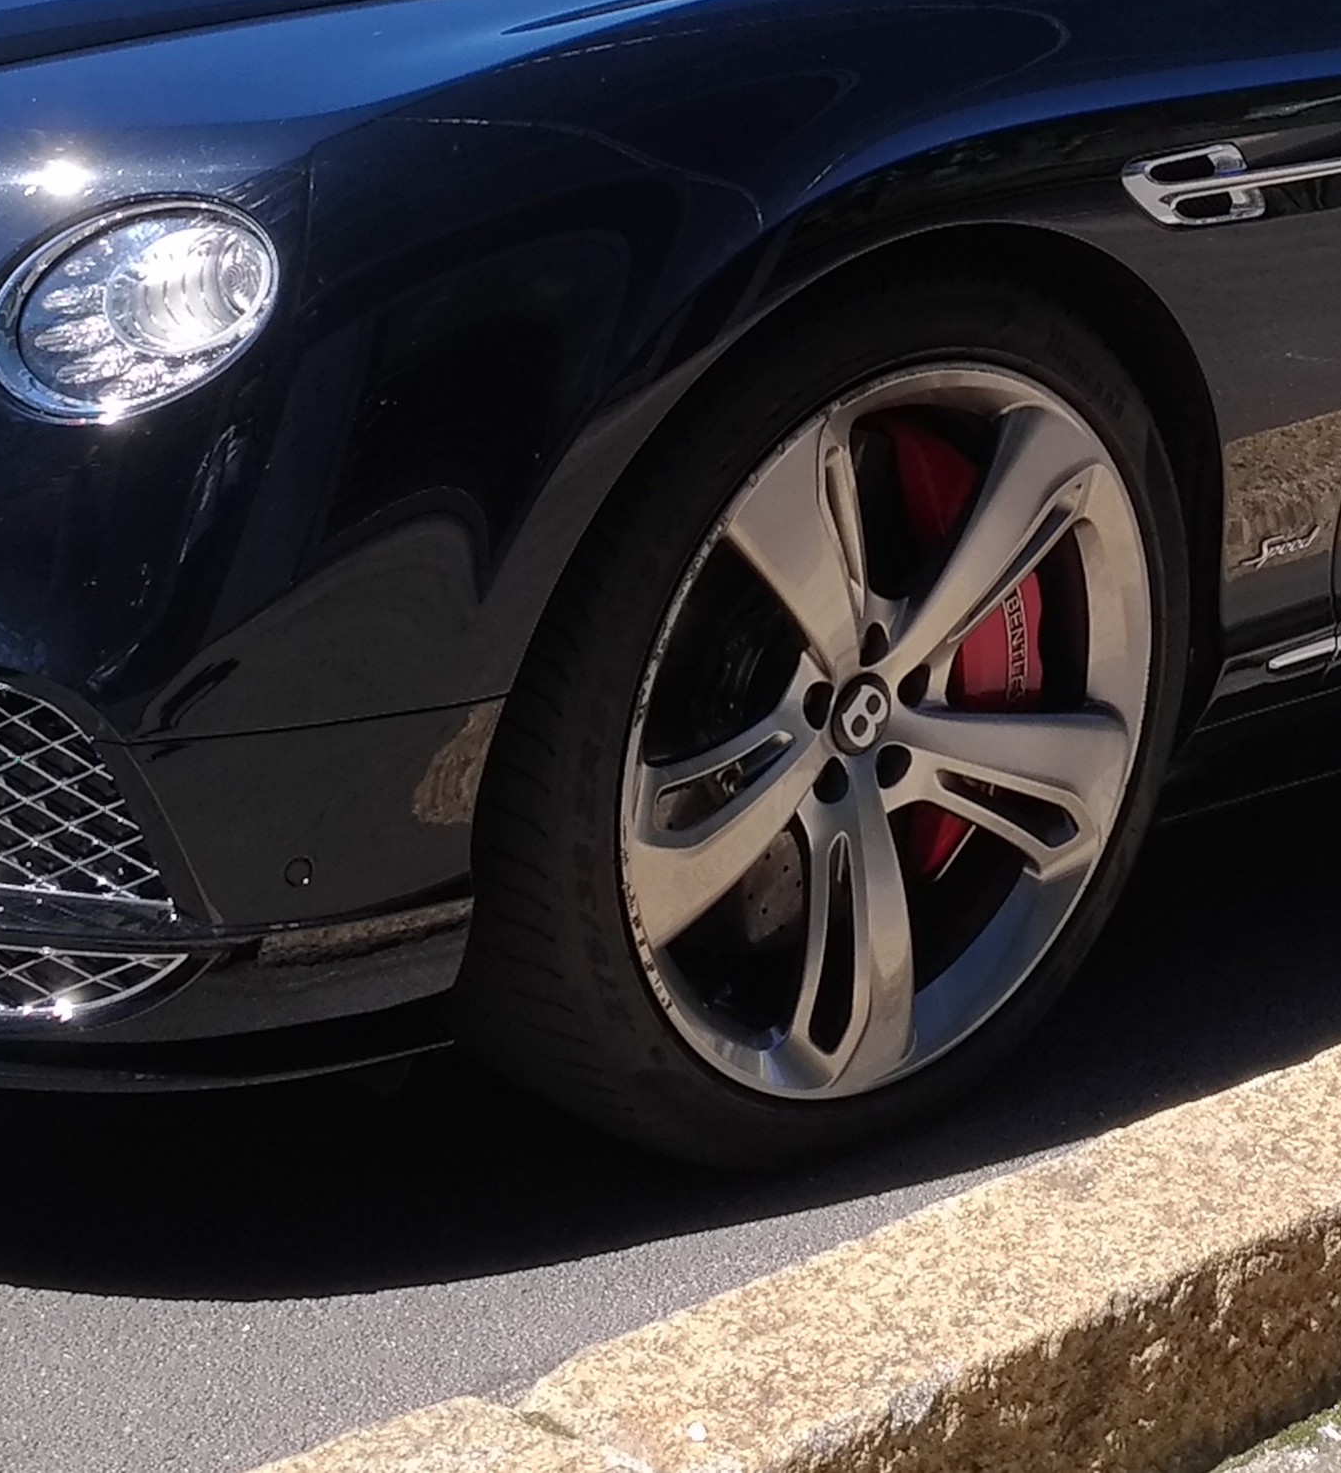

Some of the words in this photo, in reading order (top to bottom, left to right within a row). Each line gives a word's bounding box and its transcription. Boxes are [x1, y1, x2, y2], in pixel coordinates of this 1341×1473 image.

[1240, 525, 1321, 571] Speed
[1005, 594, 1026, 701] BENTLEY
[841, 684, 888, 748] B
